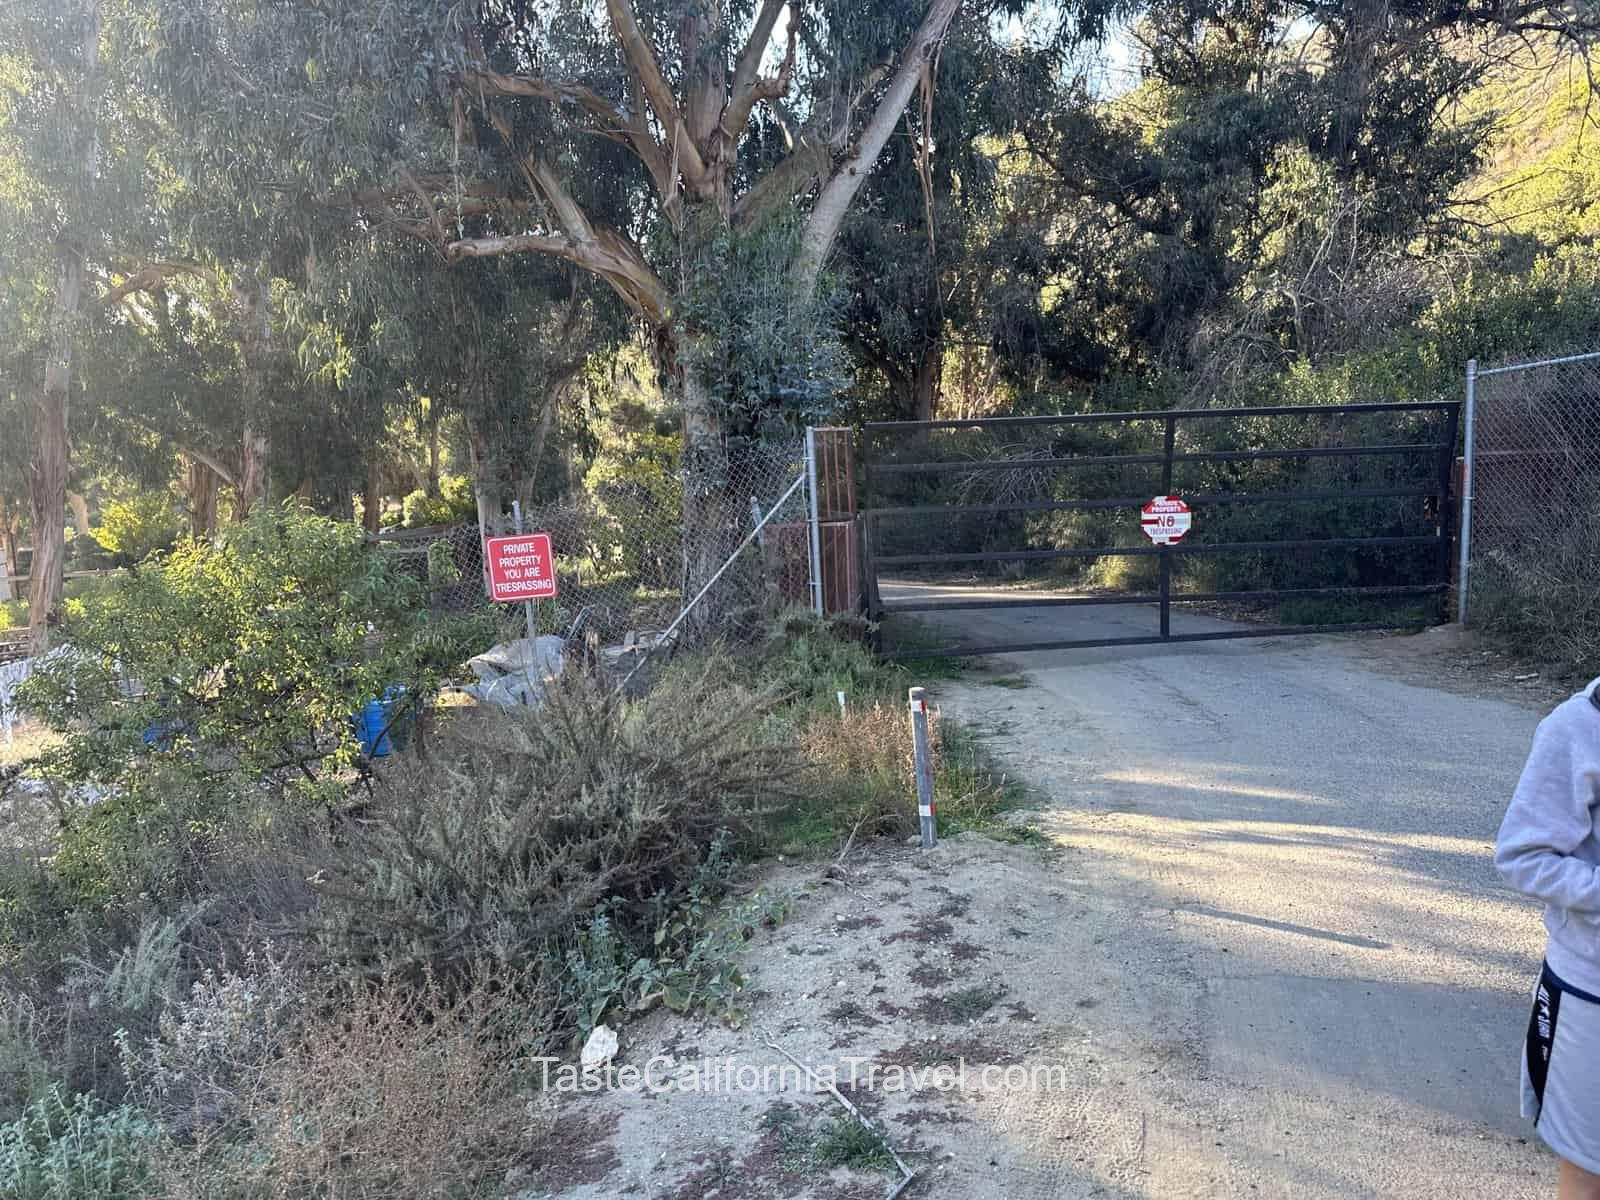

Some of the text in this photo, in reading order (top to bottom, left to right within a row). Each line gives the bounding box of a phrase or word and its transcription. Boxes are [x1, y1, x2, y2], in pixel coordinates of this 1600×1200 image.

[1157, 515, 1175, 527] NO
[503, 543, 535, 554] PRIVATE
[499, 555, 541, 567] PROPERTY
[503, 567, 541, 579] YOU ARE
[495, 579, 552, 592] TRESPASSING
